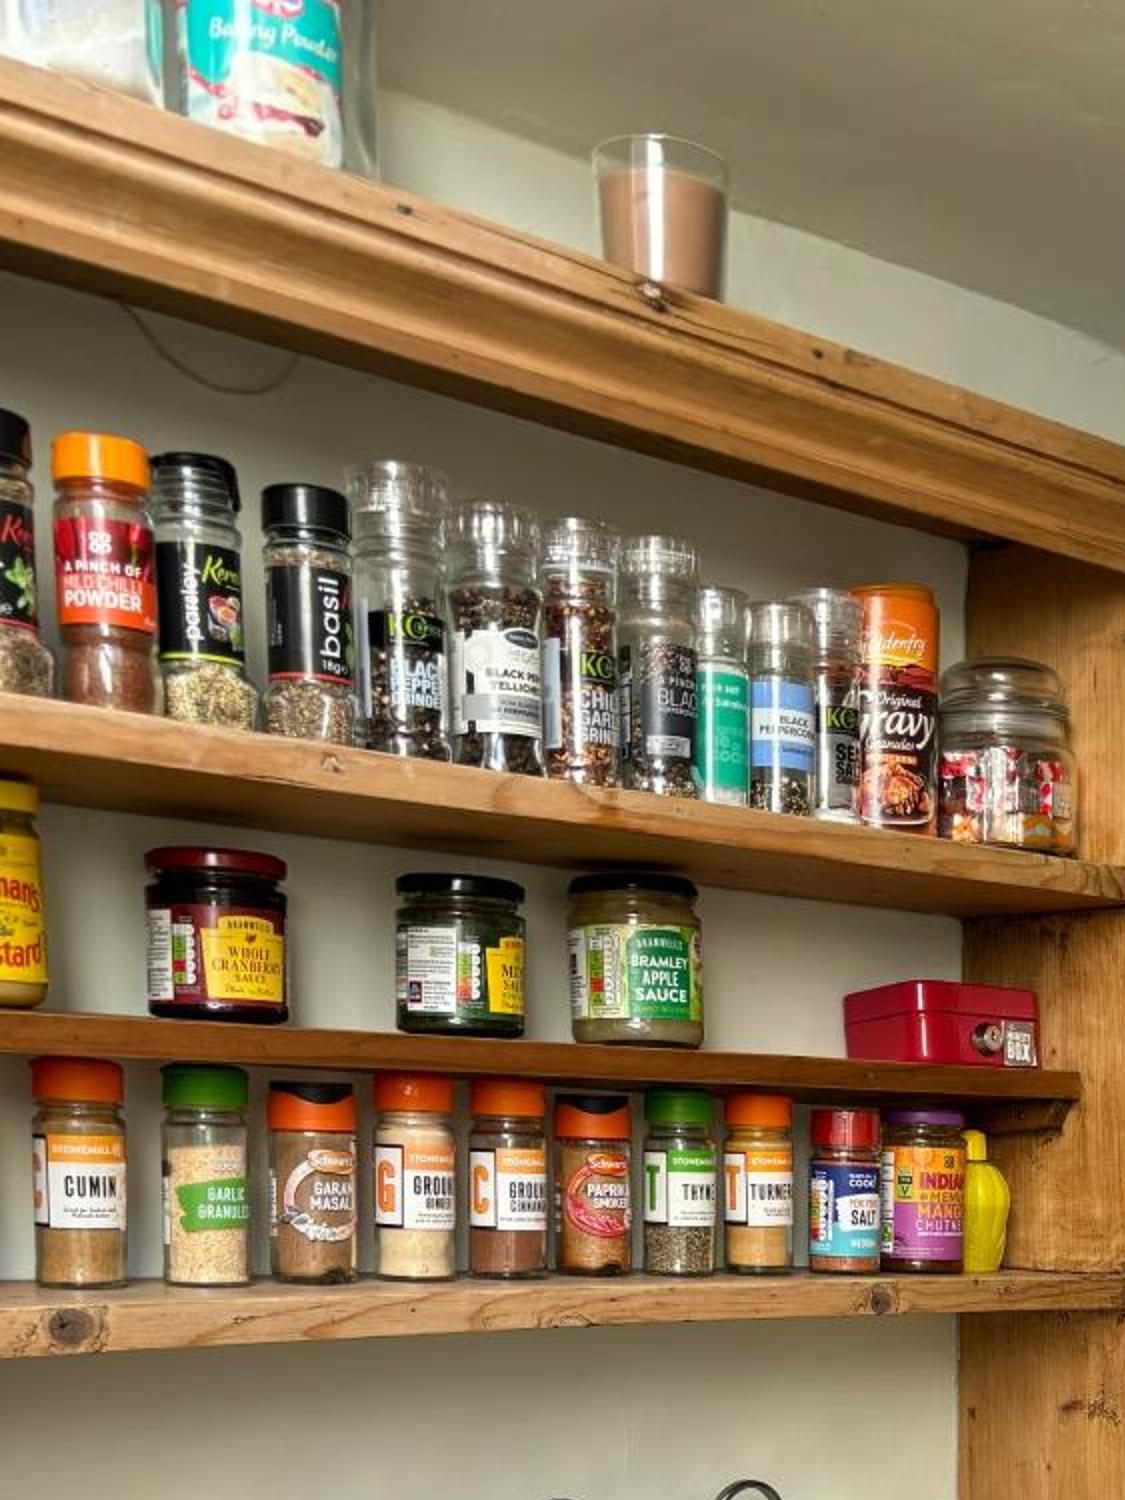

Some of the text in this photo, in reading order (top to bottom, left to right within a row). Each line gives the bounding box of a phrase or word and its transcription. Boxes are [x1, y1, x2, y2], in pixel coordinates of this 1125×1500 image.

[209, 15, 277, 48] Baing
[64, 559, 142, 578] A PINCH OF
[64, 588, 142, 612] POWDER
[181, 562, 205, 642] parsley
[317, 576, 341, 659] basil
[656, 687, 698, 708] BLAC
[0, 935, 42, 968] tard
[630, 953, 689, 970] BRAMLEY
[642, 970, 679, 987] APPLE
[635, 987, 688, 1003] SAUCE
[63, 1174, 118, 1199] CUMIN
[413, 1174, 454, 1197] GROU
[509, 1180, 545, 1199] GROU
[919, 1171, 963, 1191] INDIA
[197, 1202, 250, 1220] GRANUL
[310, 1195, 354, 1212] MASAL
[593, 1197, 628, 1210] SMOKE
[851, 1208, 877, 1227] SALT
